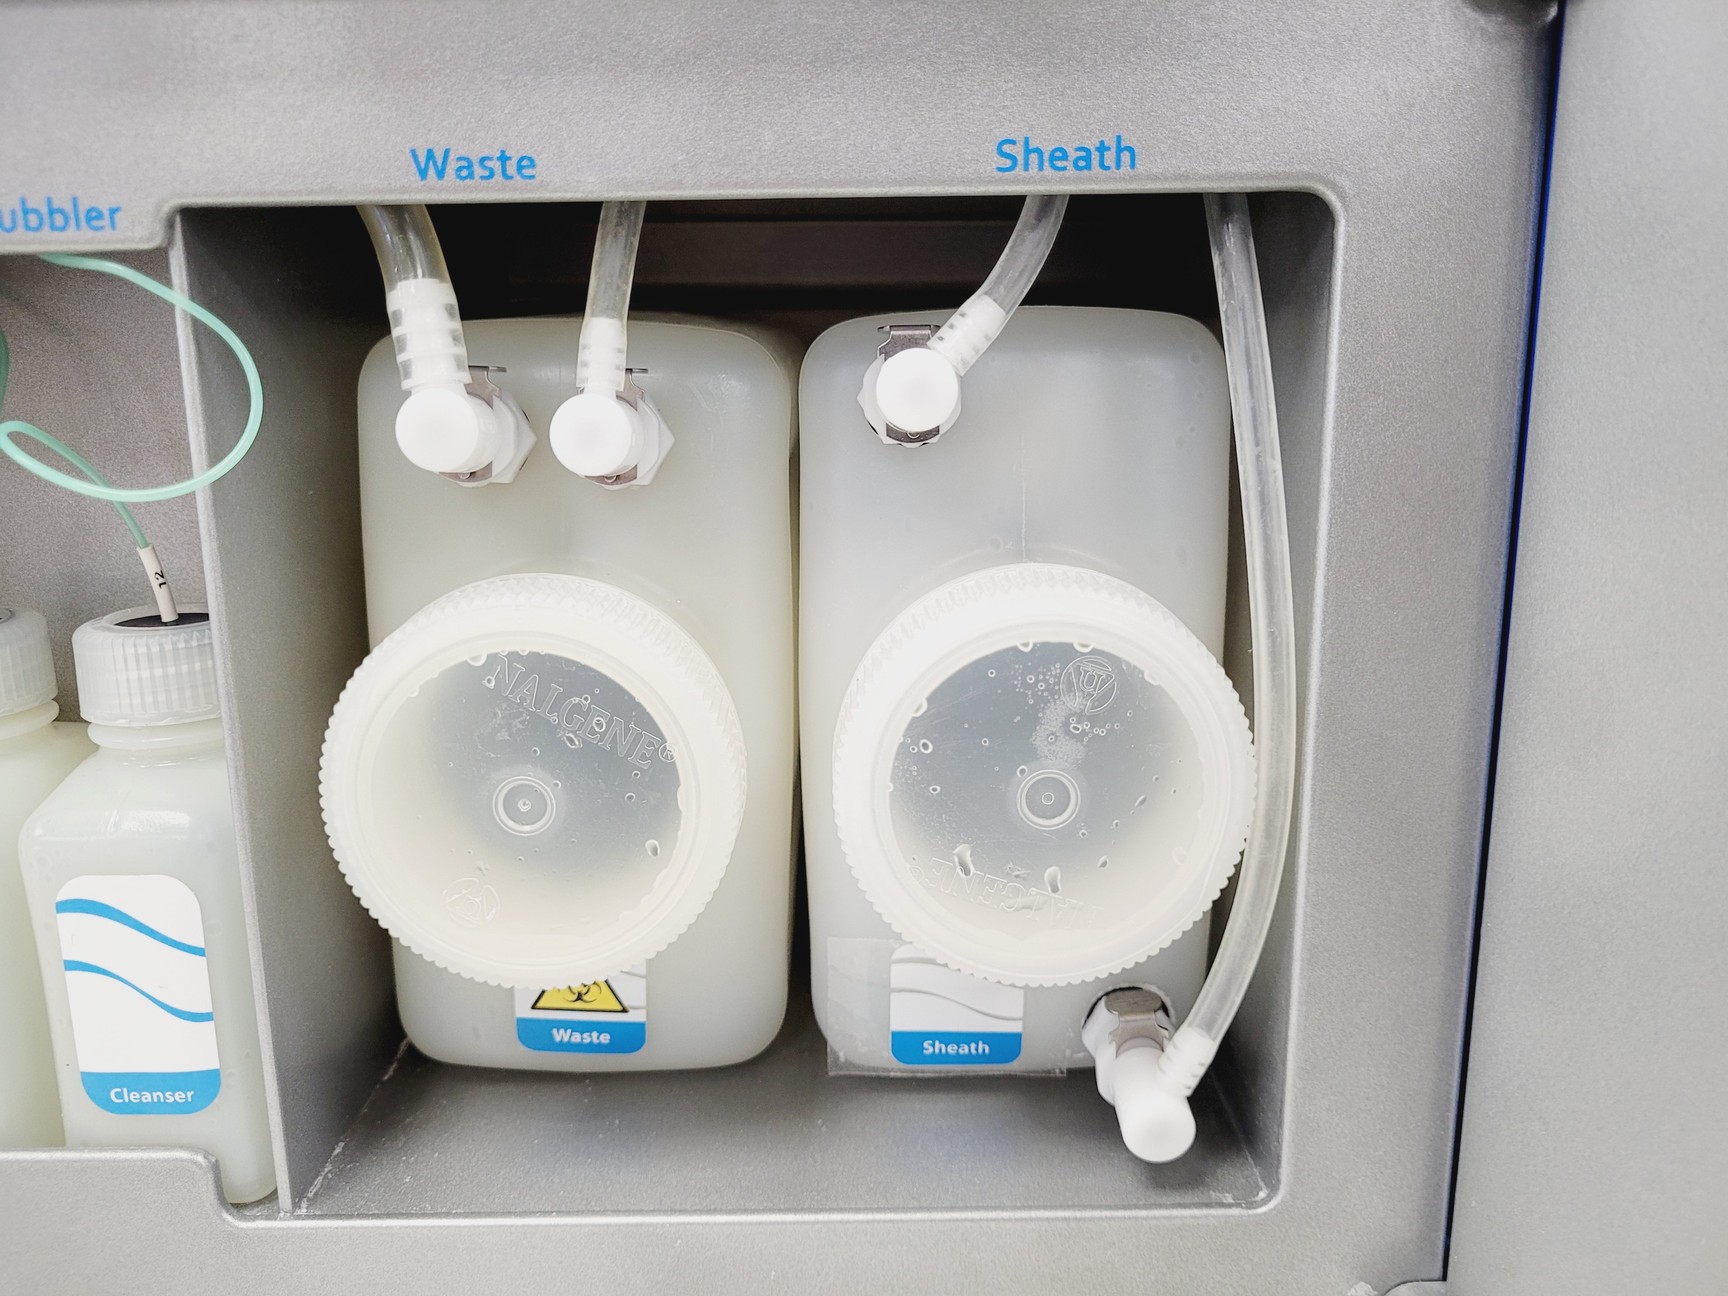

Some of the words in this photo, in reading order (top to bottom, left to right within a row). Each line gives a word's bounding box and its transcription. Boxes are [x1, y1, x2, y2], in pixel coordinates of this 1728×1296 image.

[995, 133, 1137, 174] Sheath
[410, 147, 538, 182] Waste
[154, 569, 167, 589] 12
[552, 1027, 611, 1044] Waste
[922, 1039, 990, 1055] Sheath
[109, 1087, 194, 1103] Cleanser
